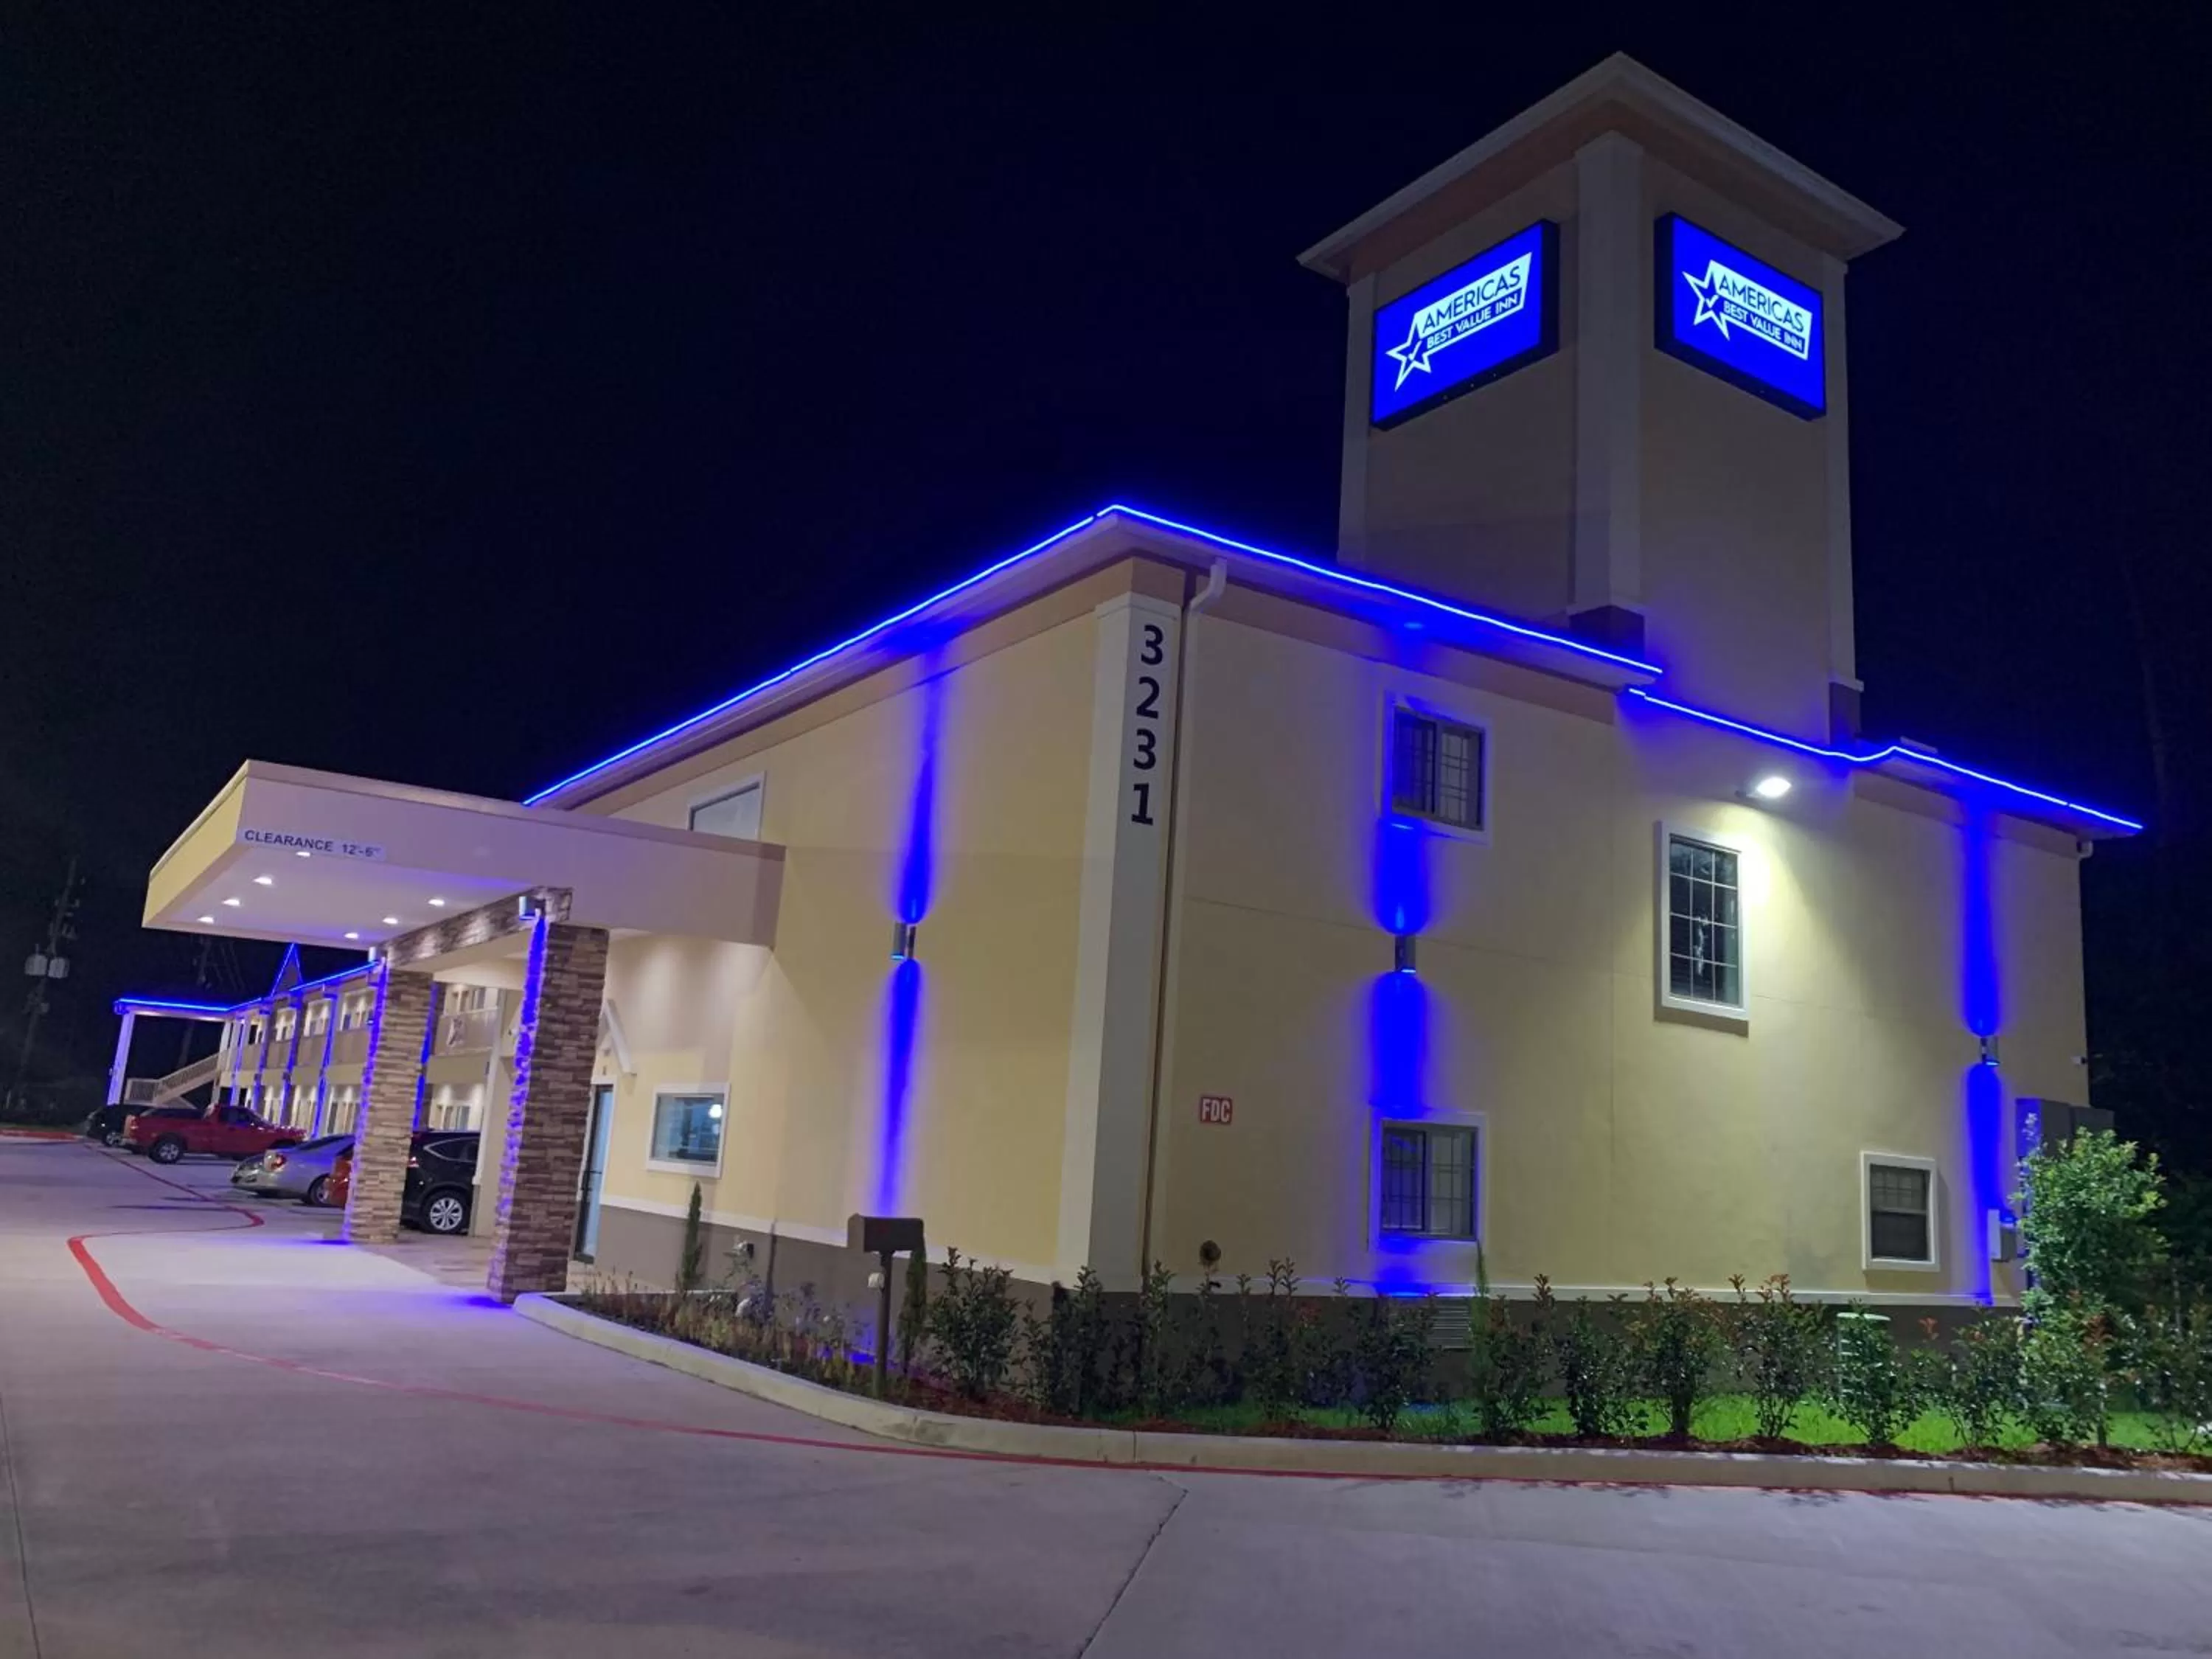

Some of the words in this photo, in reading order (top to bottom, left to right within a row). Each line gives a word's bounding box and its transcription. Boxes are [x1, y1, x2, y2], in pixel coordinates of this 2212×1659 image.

[1422, 265, 1521, 333] AMERICAS
[1427, 326, 1454, 349] BEST
[1455, 309, 1492, 332] VALUE
[1495, 293, 1518, 315] INN
[1719, 274, 1804, 333] AMERICAS
[1723, 299, 1748, 322] BEST
[1750, 313, 1782, 340] VALUE
[1784, 331, 1803, 352] INN
[1131, 624, 1164, 826] 3231
[244, 830, 334, 852] CLEARANCE
